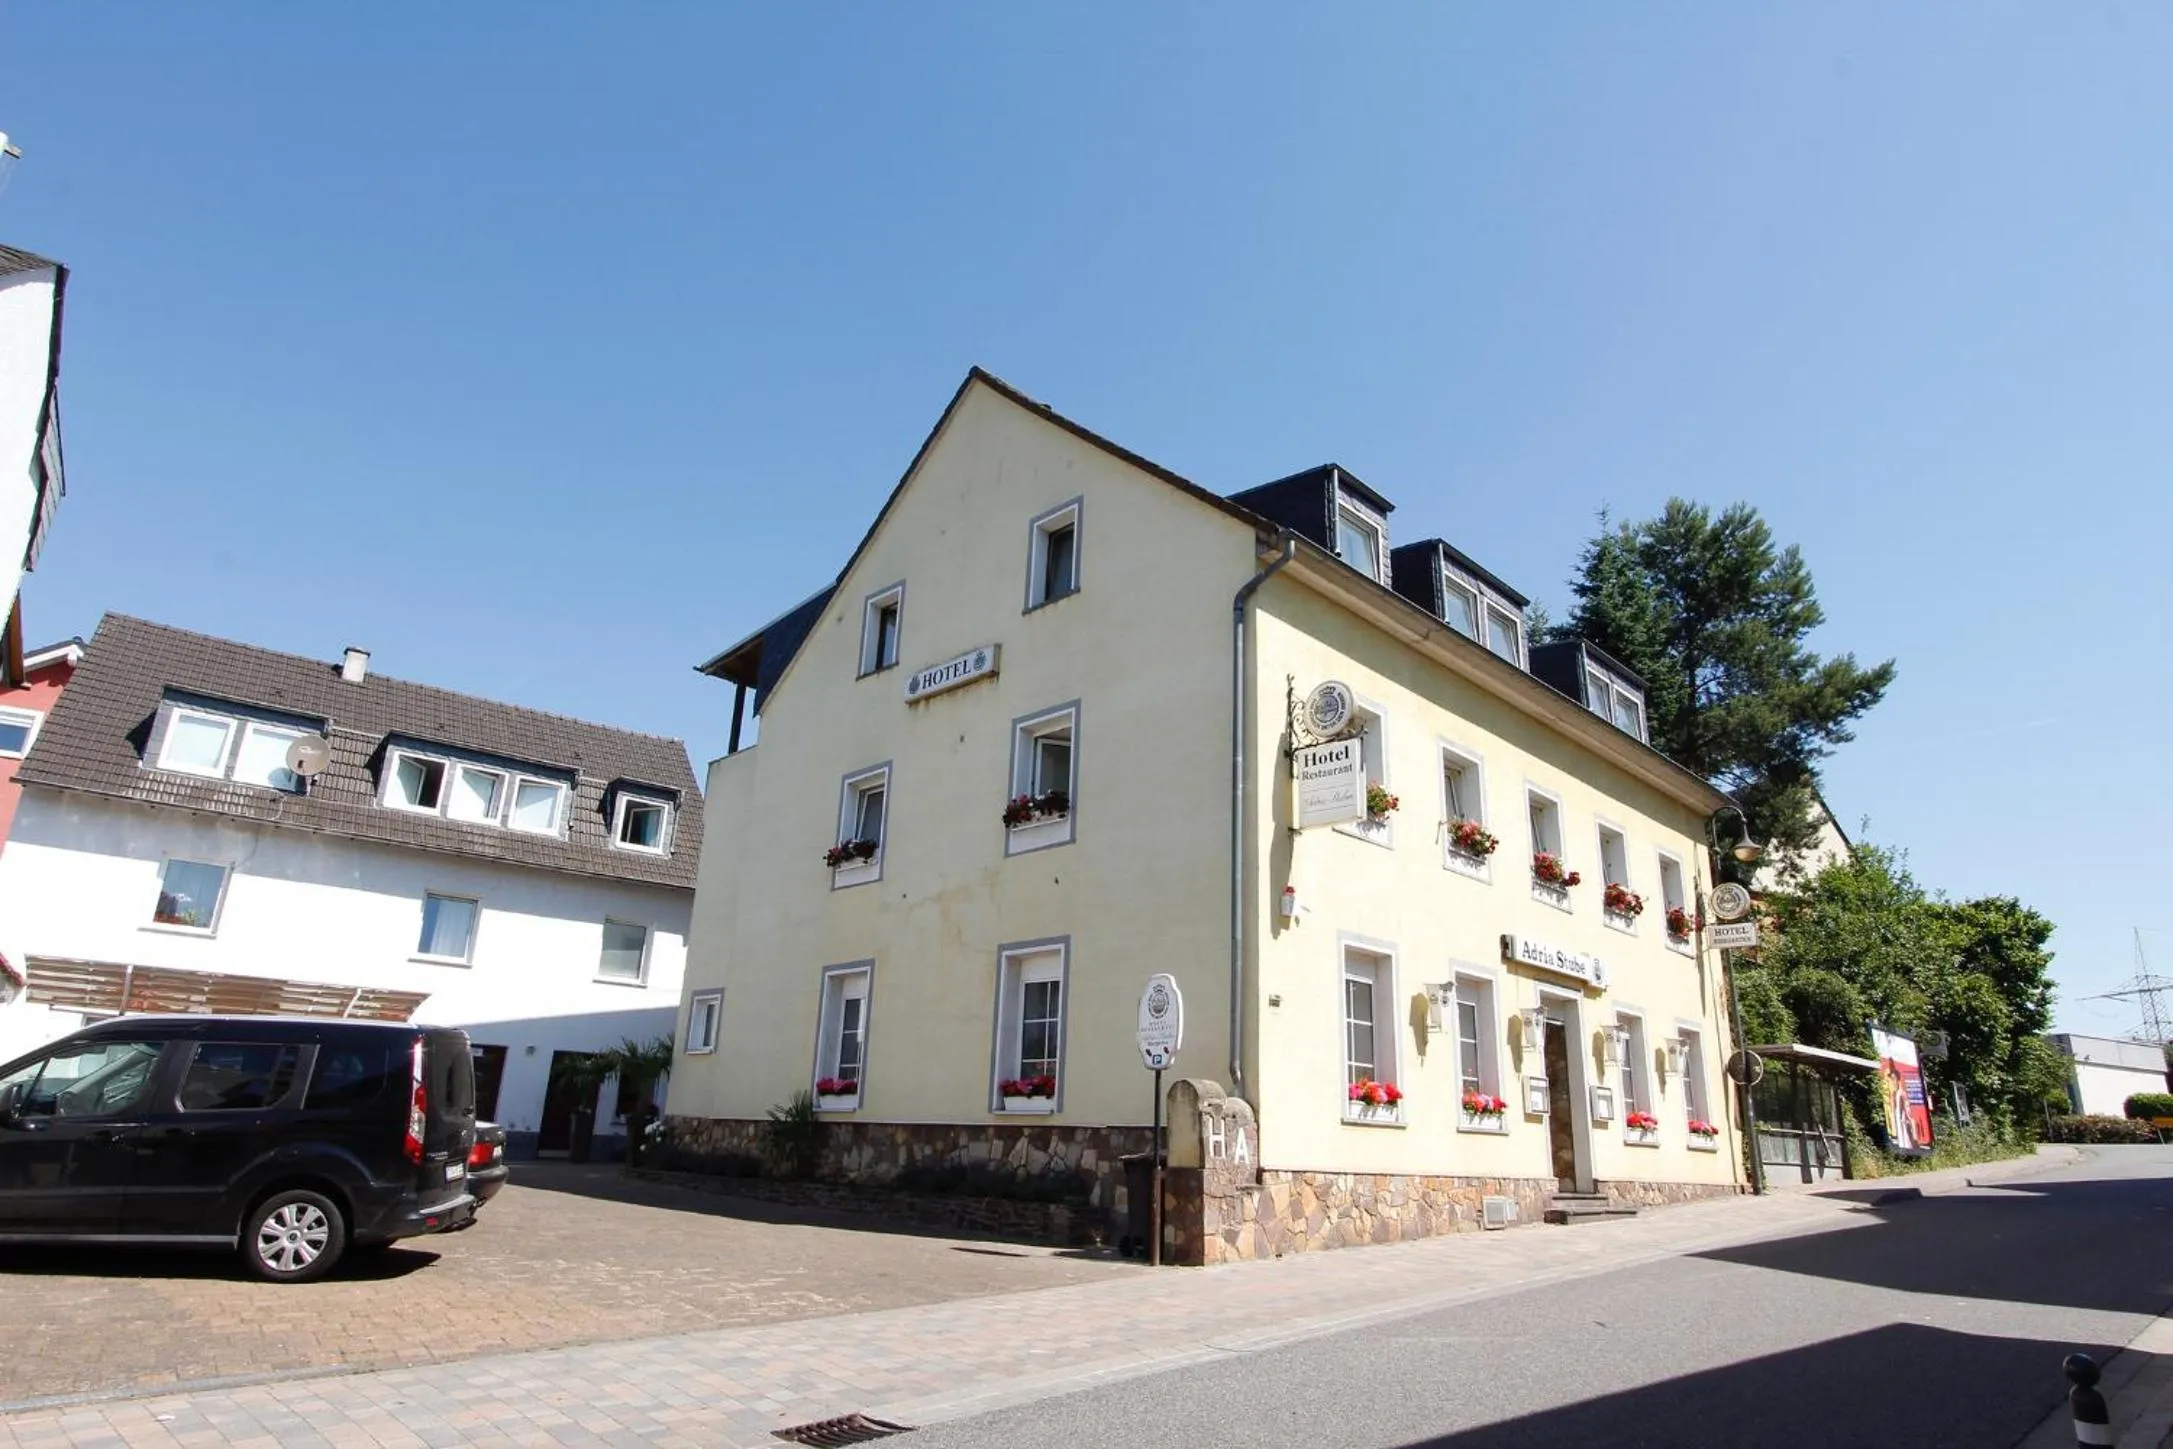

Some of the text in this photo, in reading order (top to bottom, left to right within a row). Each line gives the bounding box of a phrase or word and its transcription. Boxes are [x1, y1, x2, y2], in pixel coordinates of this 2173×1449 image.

[921, 659, 972, 690] HOTEL
[1304, 745, 1350, 768] Hotel
[1302, 764, 1353, 782] Restaurant
[1714, 925, 1750, 937] HOTEL
[1522, 940, 1586, 975] Adria Stube
[1209, 1116, 1250, 1167] H A
